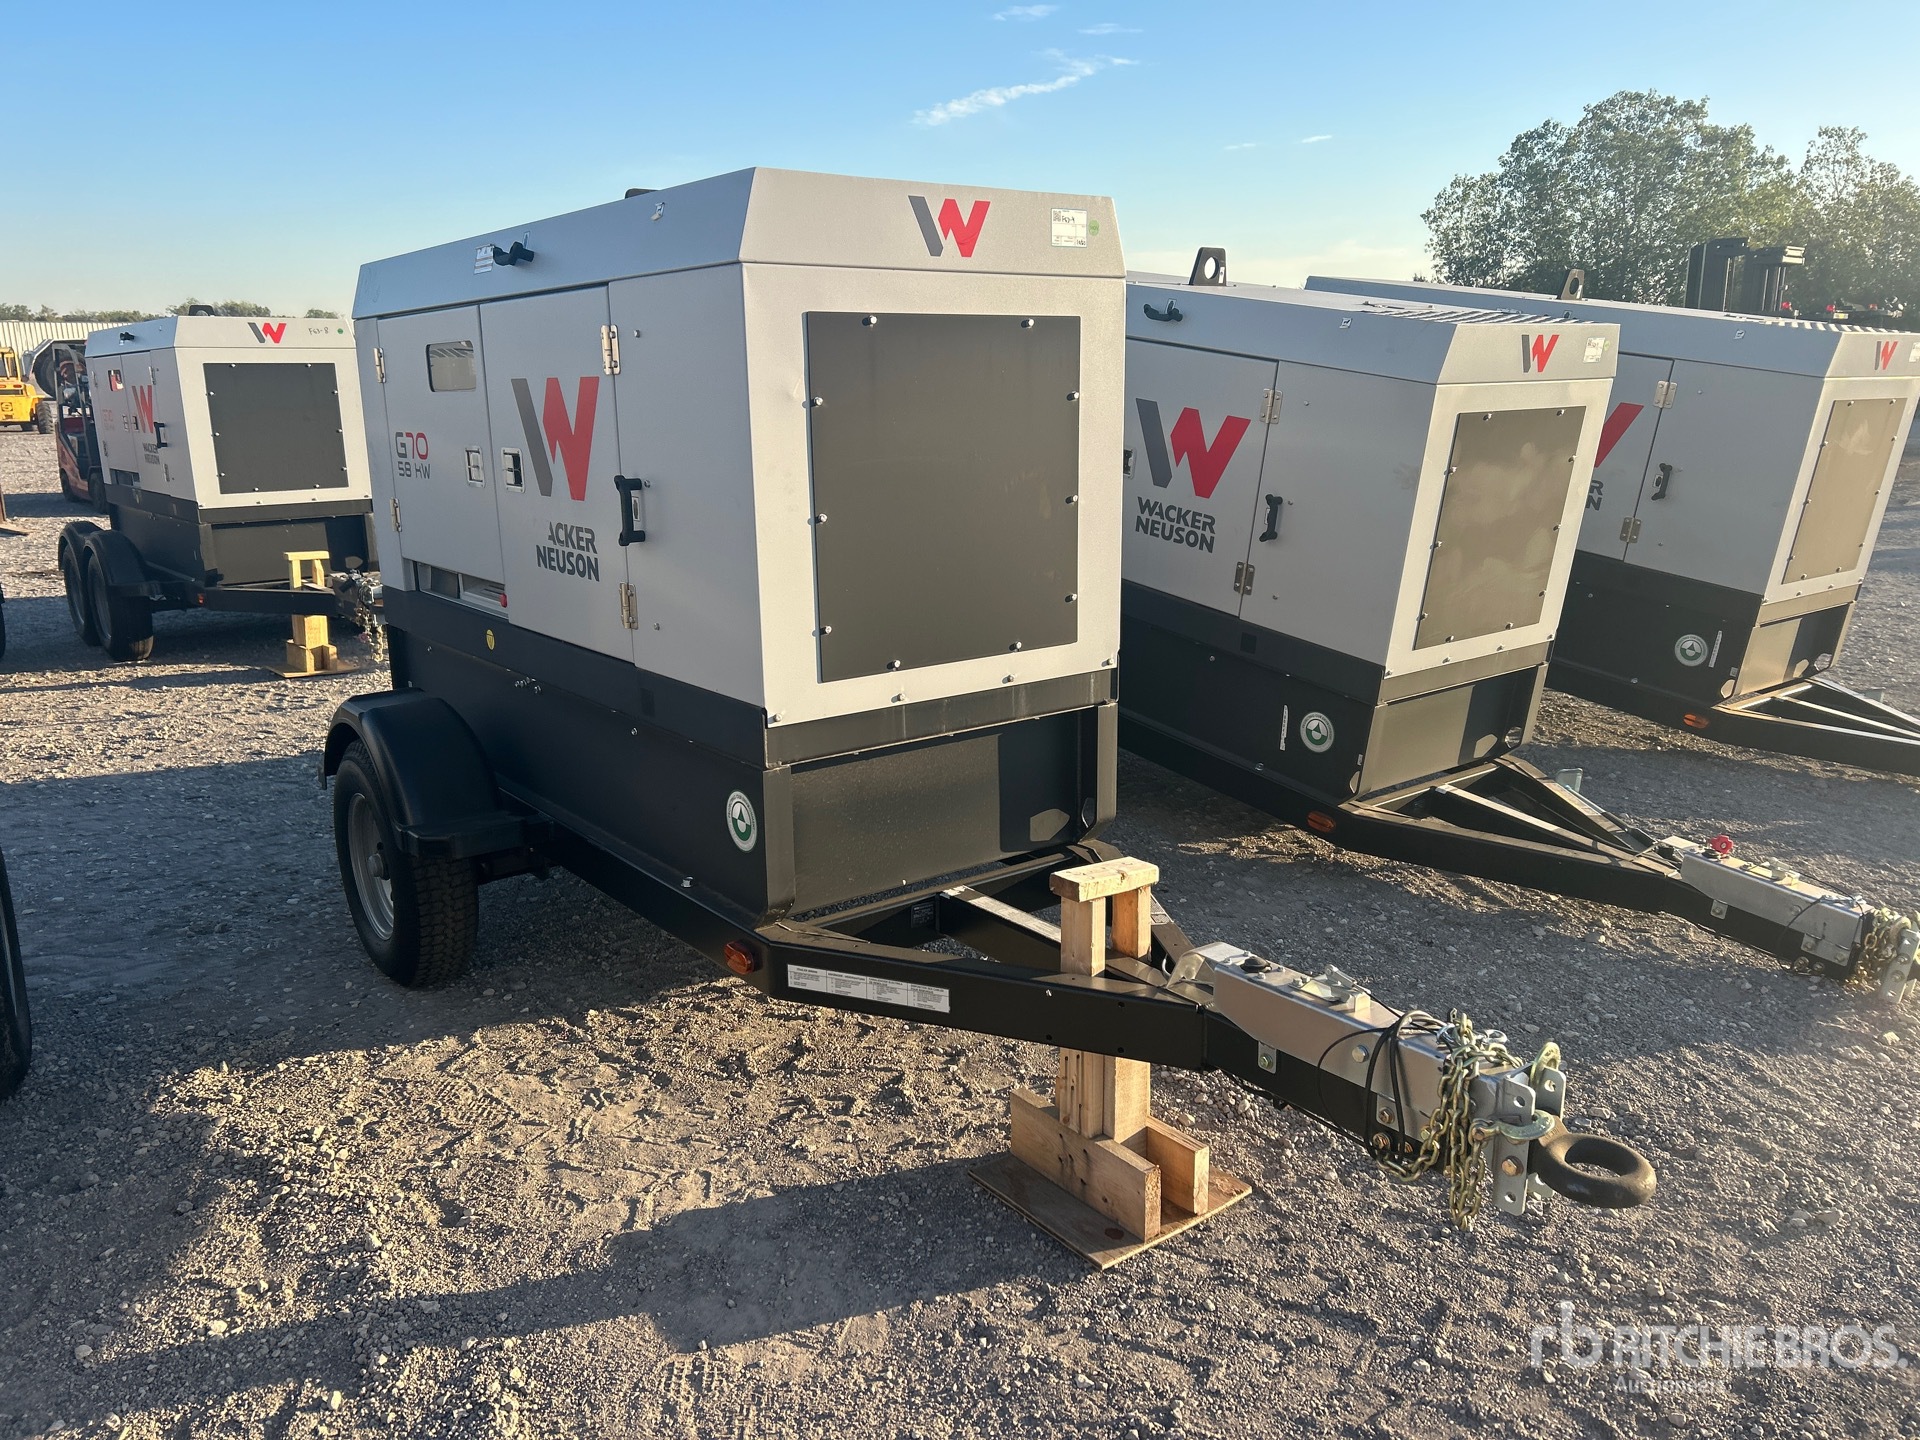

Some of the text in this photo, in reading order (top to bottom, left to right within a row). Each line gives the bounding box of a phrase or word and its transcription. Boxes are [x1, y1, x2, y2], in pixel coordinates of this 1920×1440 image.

[395, 431, 429, 461] G70
[397, 461, 412, 478] 58
[1137, 496, 1216, 534] WACKER
[1135, 515, 1215, 554] NEUSON
[536, 544, 600, 582] NEUSON
